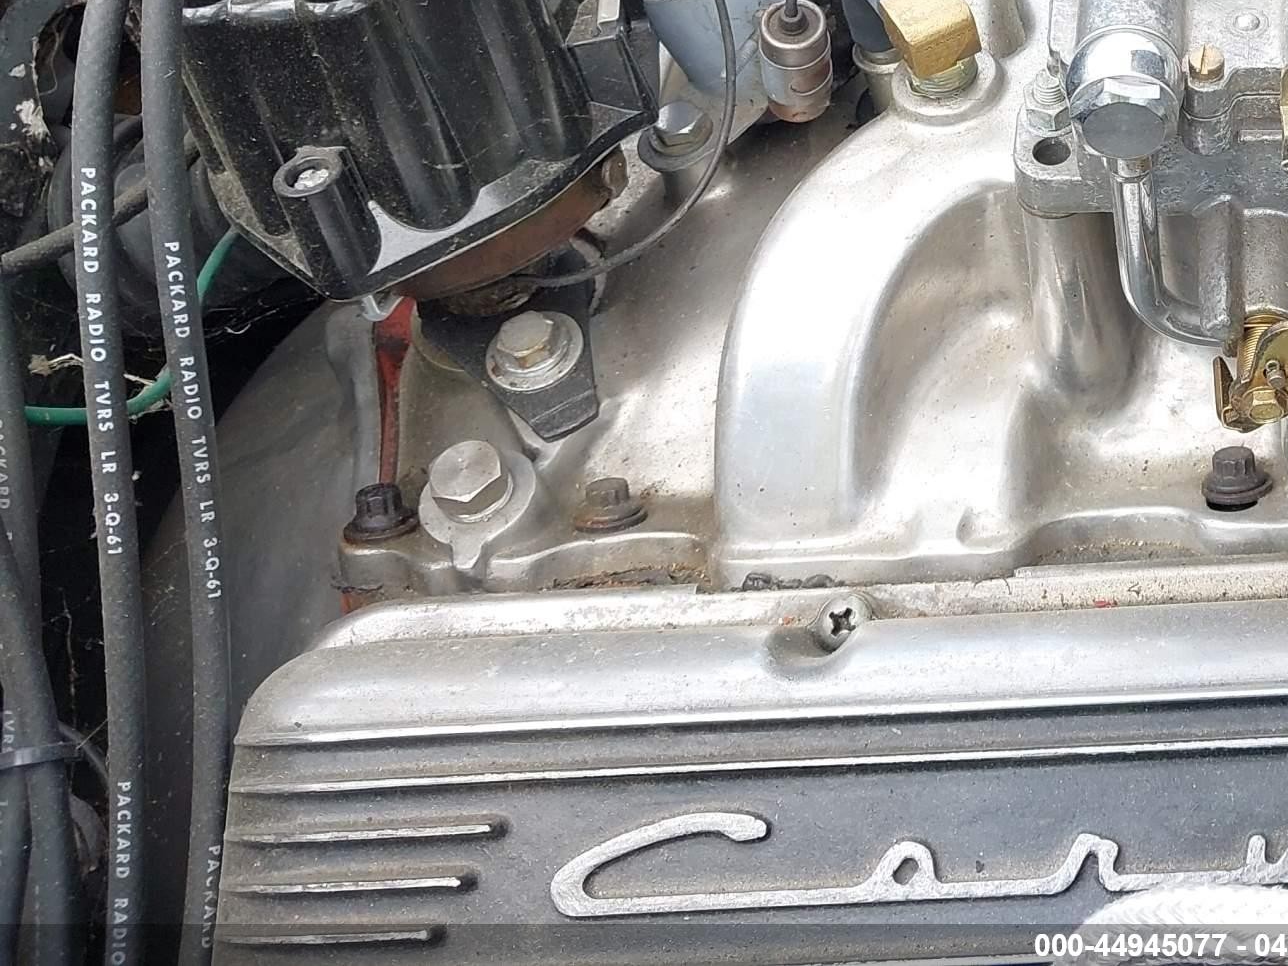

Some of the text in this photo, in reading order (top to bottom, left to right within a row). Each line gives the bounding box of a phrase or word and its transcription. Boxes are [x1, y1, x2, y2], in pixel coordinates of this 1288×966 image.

[80, 167, 123, 555] PACKARD RADIO TVRS LR 3-Q-61
[164, 241, 222, 600] PACKARD RADIO TVRS LR 3-Q-61
[110, 781, 132, 965] PACKARD RADIO
